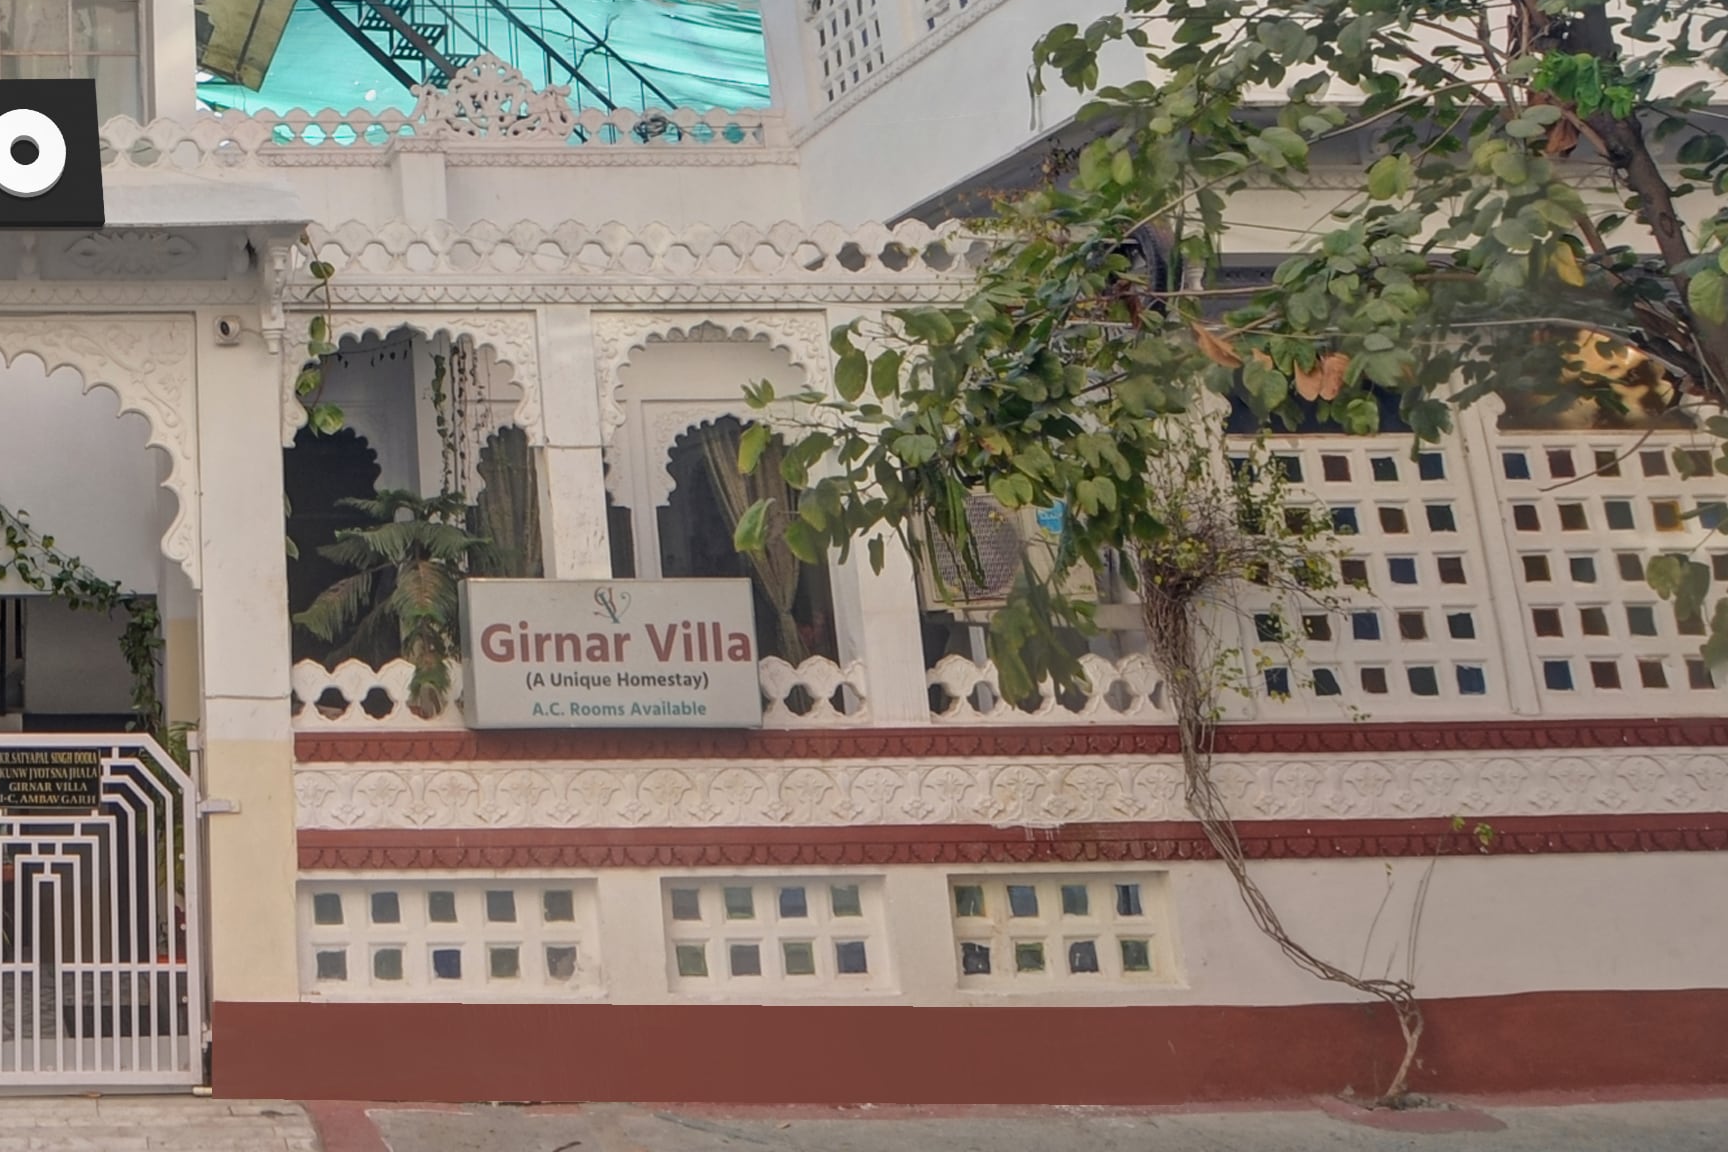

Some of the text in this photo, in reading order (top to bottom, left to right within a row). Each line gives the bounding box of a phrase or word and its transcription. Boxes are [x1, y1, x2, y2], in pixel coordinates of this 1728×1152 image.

[480, 620, 752, 663] Girnar Villa
[526, 671, 709, 690] (A Unique Homestay)
[532, 701, 707, 717] A.C. Rooms Available
[8, 781, 88, 792] GIRNAR VILLA
